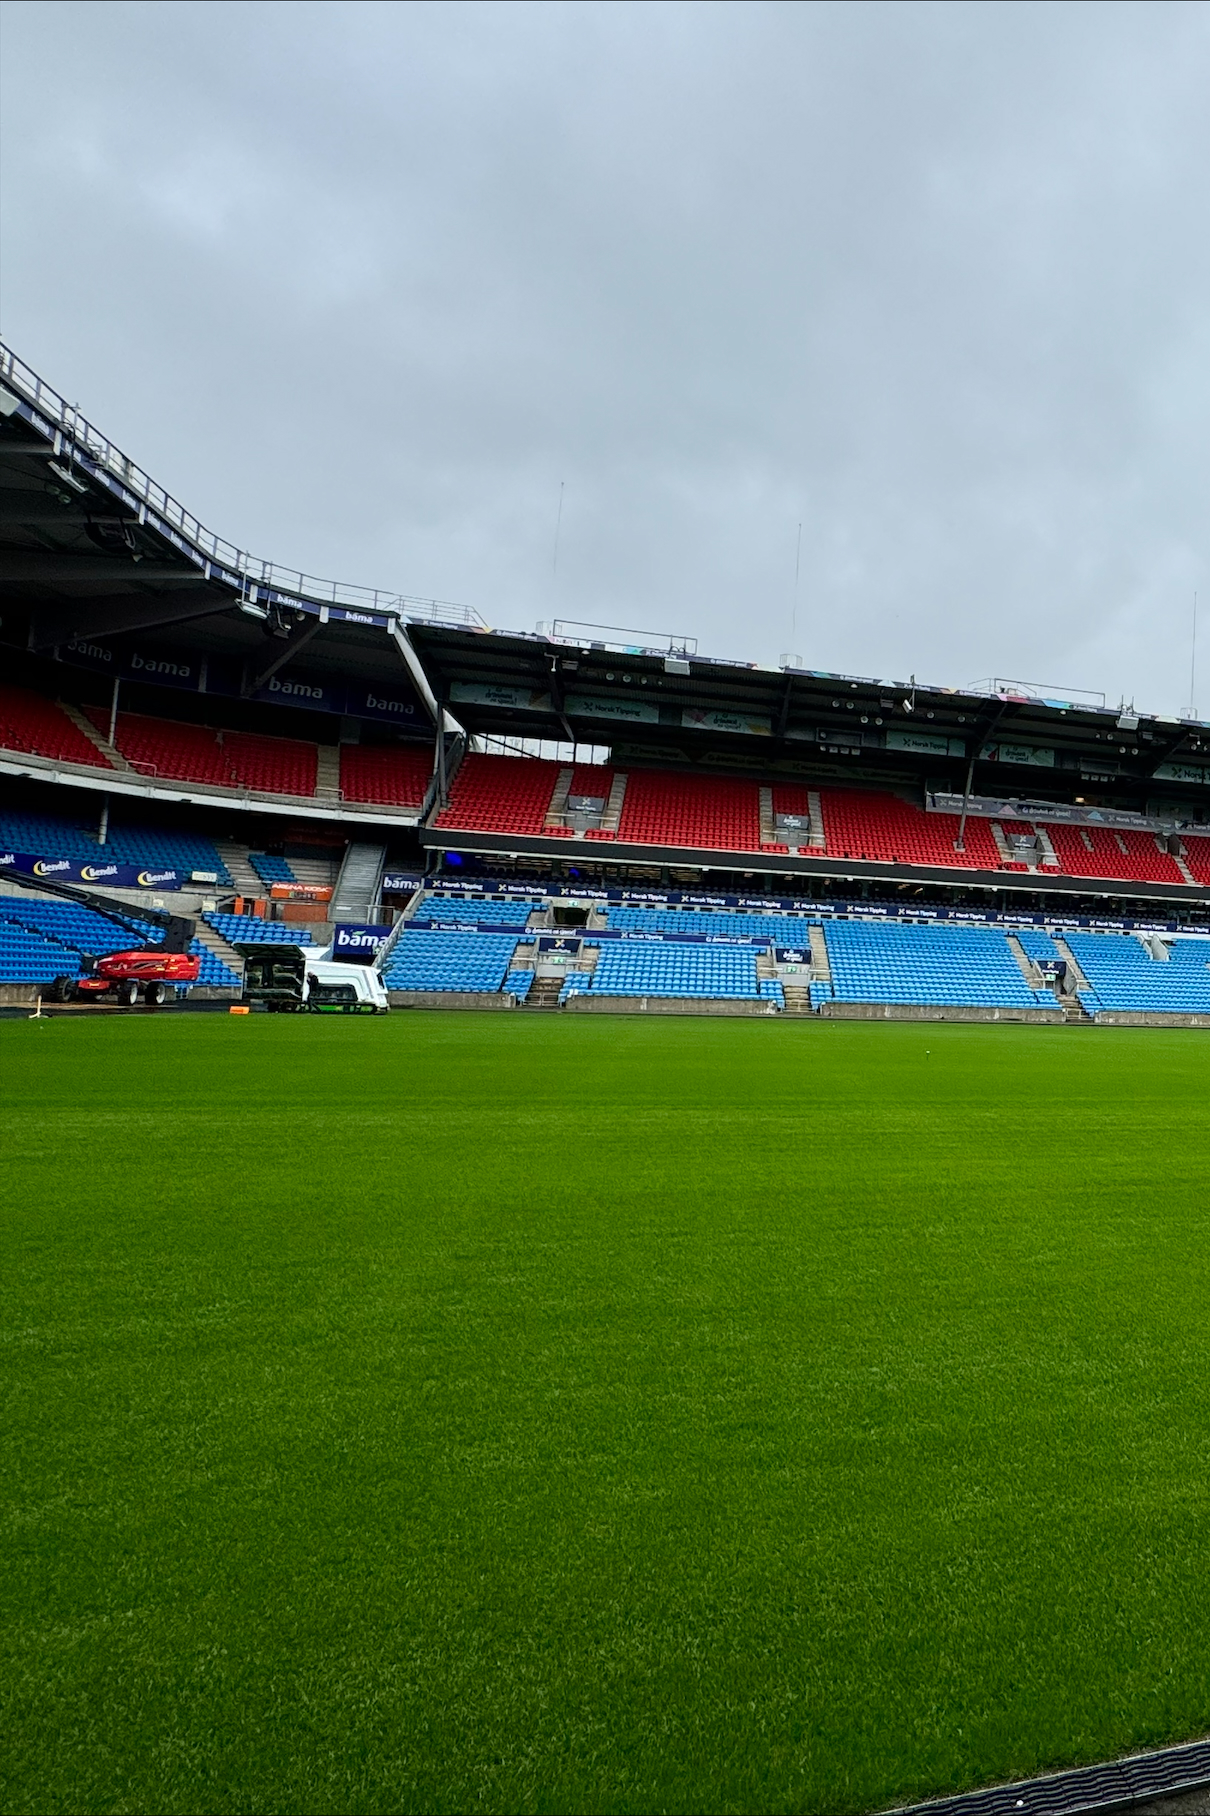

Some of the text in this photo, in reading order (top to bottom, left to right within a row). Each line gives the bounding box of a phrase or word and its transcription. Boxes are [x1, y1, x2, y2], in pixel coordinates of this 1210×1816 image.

[277, 594, 303, 608] bama
[346, 610, 374, 624] bama
[131, 653, 191, 678] bama
[269, 677, 324, 699] bama
[366, 694, 415, 715] bama
[596, 705, 641, 716] Norsk Tipping
[1184, 768, 1205, 778] Norsk
[40, 860, 71, 873] Bendit
[89, 865, 118, 877] Bendit
[146, 871, 177, 882] Bendit
[272, 883, 303, 892] ARENA
[384, 877, 420, 890] bama
[461, 882, 483, 891] Tipping
[526, 886, 547, 894] Tipping
[338, 931, 388, 948] bama
